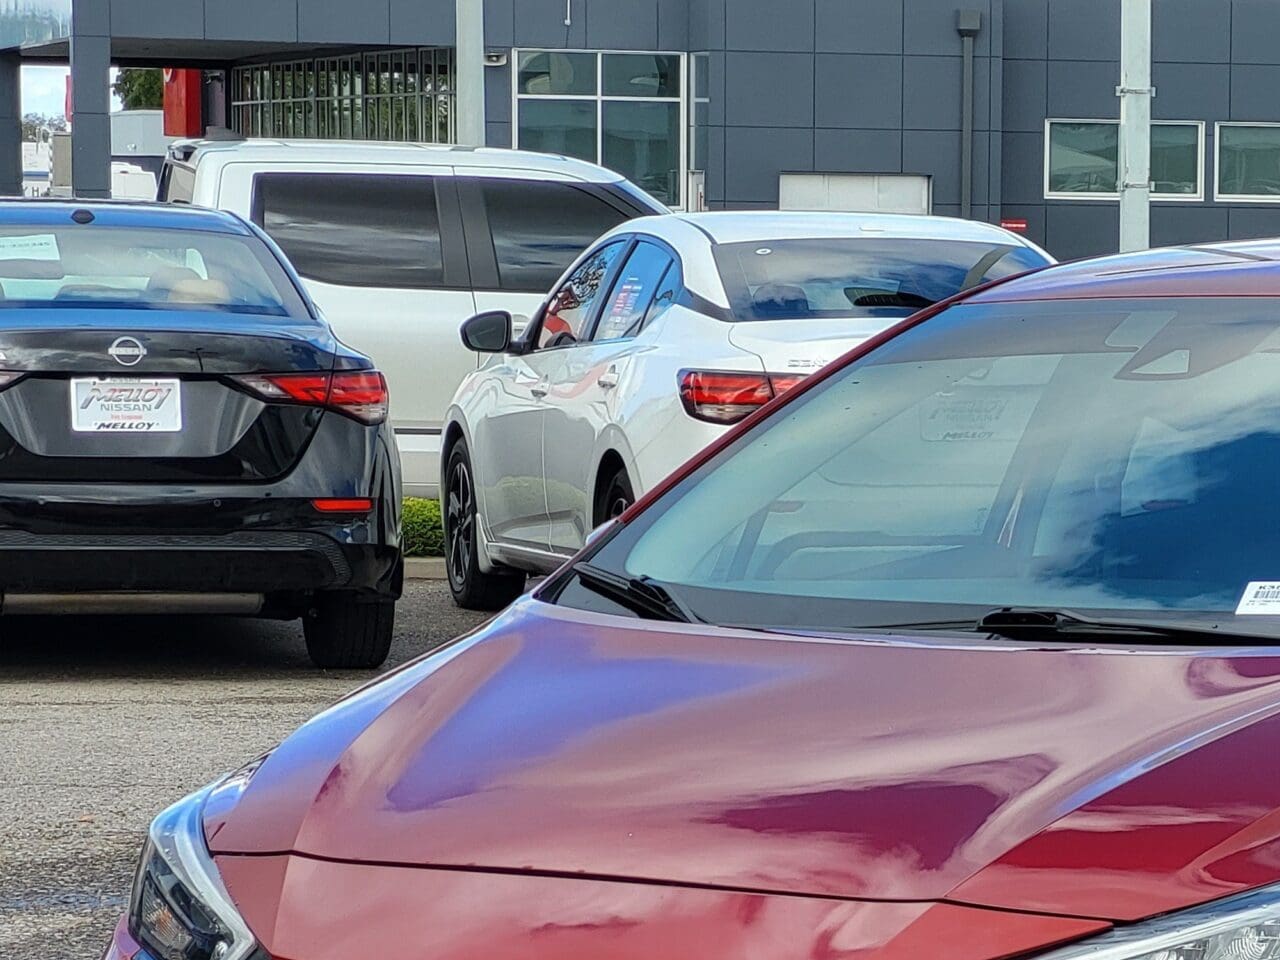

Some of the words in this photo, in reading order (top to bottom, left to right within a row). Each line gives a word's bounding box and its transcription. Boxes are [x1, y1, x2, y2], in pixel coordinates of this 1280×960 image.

[80, 388, 172, 410] MELLOY
[100, 403, 152, 411] NISSAN
[96, 421, 155, 430] MELLOY
